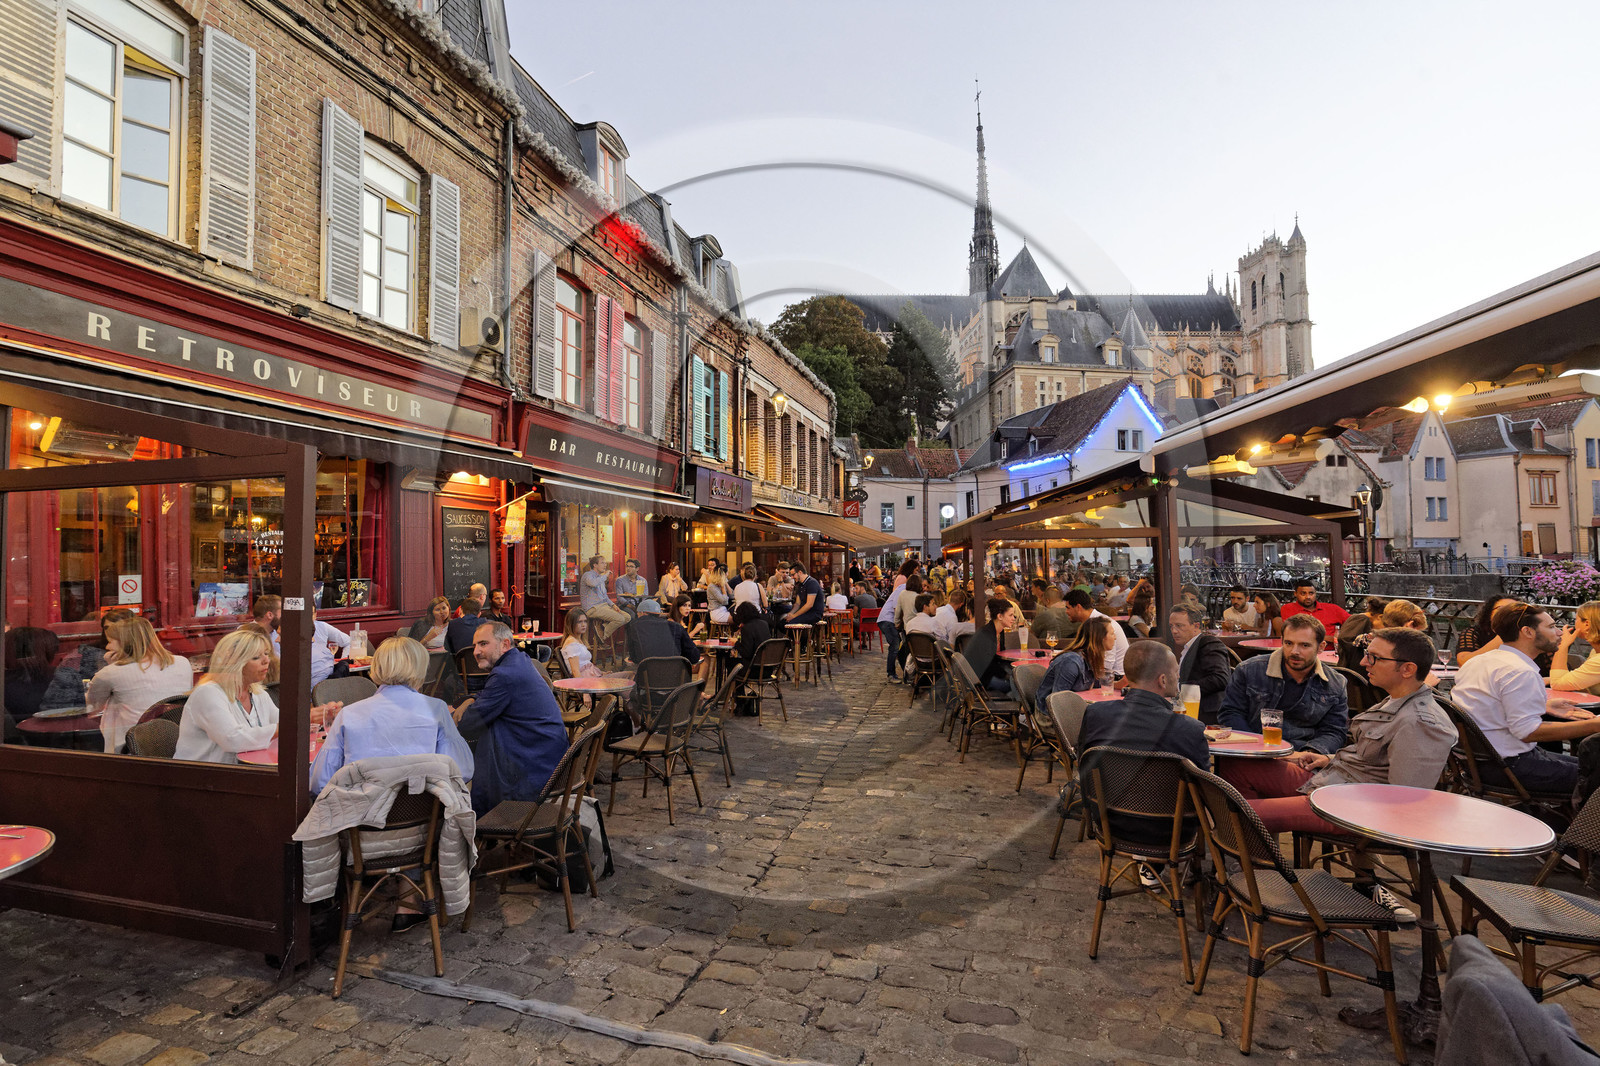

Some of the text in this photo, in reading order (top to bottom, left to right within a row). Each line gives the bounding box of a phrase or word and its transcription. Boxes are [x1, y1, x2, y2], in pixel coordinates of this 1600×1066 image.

[87, 311, 422, 418] RETROVISEUR
[549, 438, 663, 478] BAR RESTAURANT
[445, 513, 487, 525] SAUCISSON
